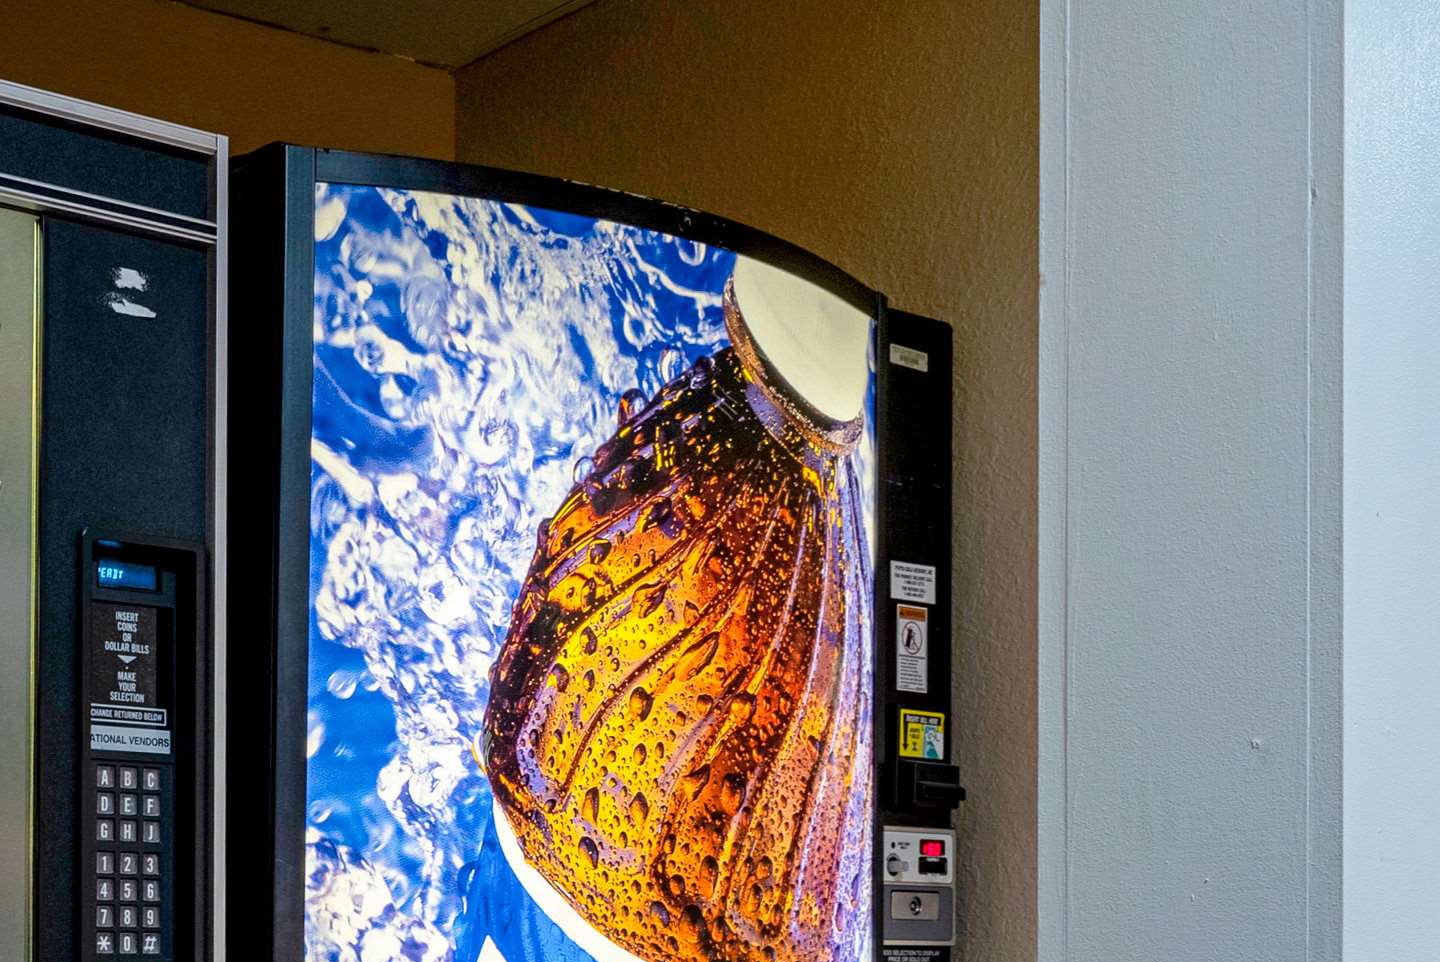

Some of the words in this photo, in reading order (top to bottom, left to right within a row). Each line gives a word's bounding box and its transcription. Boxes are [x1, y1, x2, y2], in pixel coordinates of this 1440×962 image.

[115, 611, 140, 621] INSERT
[117, 622, 138, 632] COINS
[122, 632, 132, 642] OR
[104, 640, 130, 652] DOLLAR
[131, 643, 150, 655] BILLS
[117, 671, 137, 681] MAKE
[118, 682, 137, 692] YOUR
[109, 691, 145, 703] SELECTION
[90, 708, 113, 718] CHANGE
[113, 709, 143, 720] RETURNED
[143, 711, 163, 721] BELOW
[128, 735, 170, 748] VENDORS
[101, 770, 109, 786] A
[124, 770, 132, 786] B
[147, 772, 155, 788] C
[101, 796, 109, 811] D
[124, 798, 132, 813] E
[147, 798, 154, 814] F
[100, 823, 108, 838] G
[124, 824, 132, 839] H
[148, 825, 154, 840] J
[102, 856, 107, 871] 1
[124, 857, 131, 872] 2
[147, 857, 154, 873] 3
[100, 882, 108, 897] 4
[124, 883, 131, 898] 5
[147, 883, 154, 899] 6
[101, 909, 108, 924] 7
[124, 909, 131, 925] 8
[147, 909, 154, 925] 9
[124, 936, 131, 951] 0
